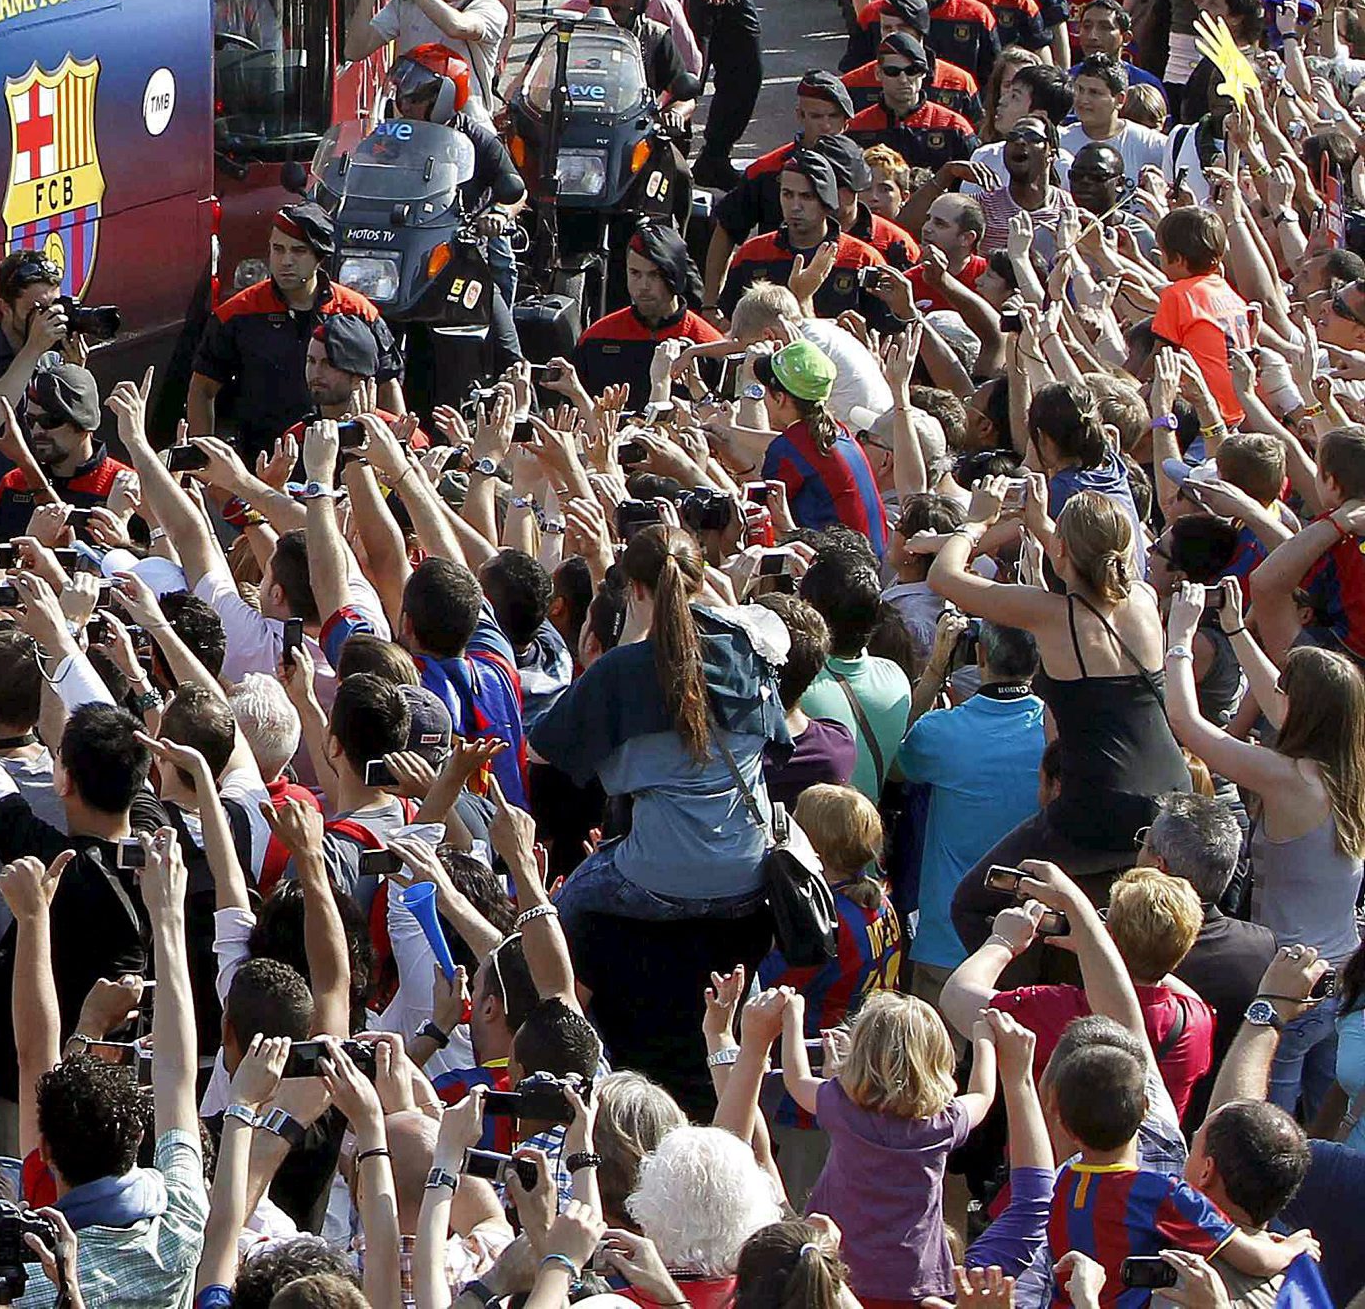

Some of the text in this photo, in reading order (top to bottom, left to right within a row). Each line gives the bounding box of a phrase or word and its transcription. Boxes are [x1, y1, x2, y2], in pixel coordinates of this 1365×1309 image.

[569, 82, 606, 100] tve
[150, 91, 171, 113] TMB
[35, 172, 74, 213] FCB
[347, 229, 395, 242] MOTOS TV
